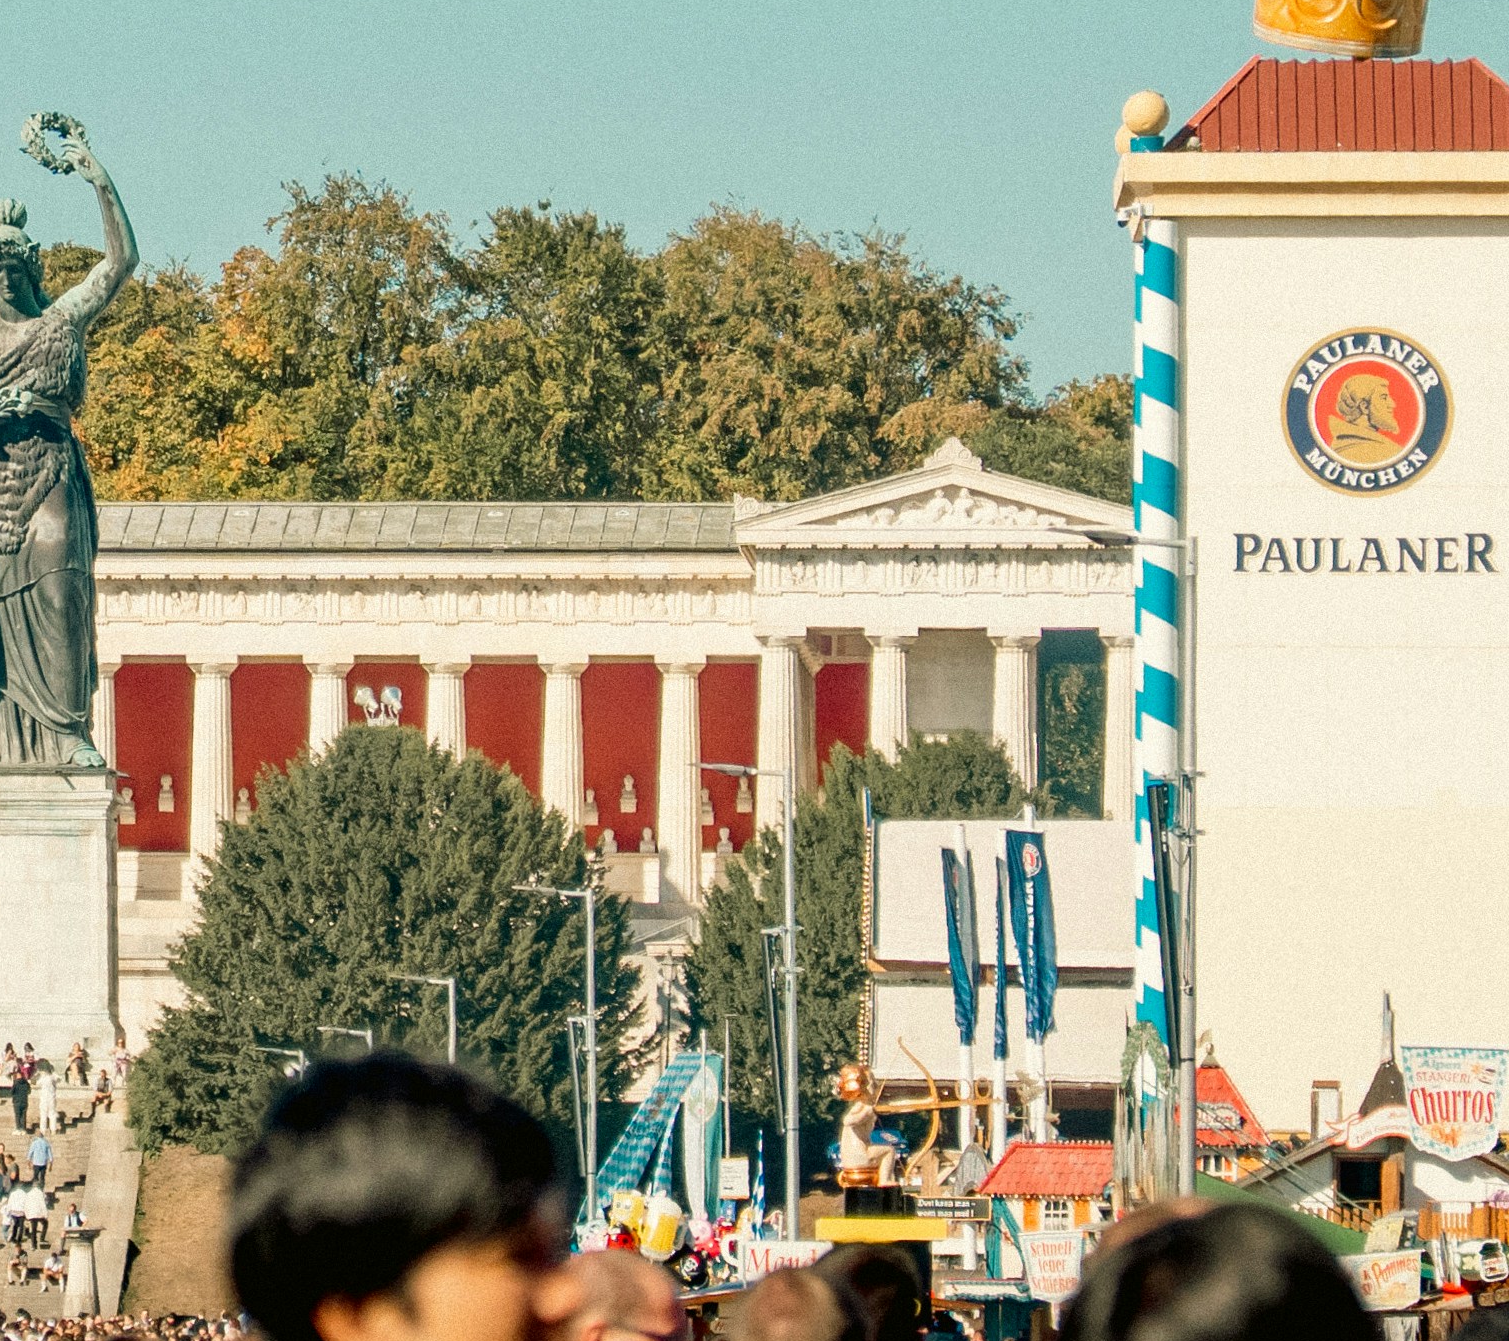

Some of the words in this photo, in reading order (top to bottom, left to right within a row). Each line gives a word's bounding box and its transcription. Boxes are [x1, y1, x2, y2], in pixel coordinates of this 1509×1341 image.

[1293, 334, 1439, 394] PAULANER
[1305, 447, 1428, 488] MÜNCHEN
[1233, 533, 1499, 573] PAULANER
[1410, 1087, 1495, 1126] Churros
[1371, 1259, 1418, 1289] Pommes
